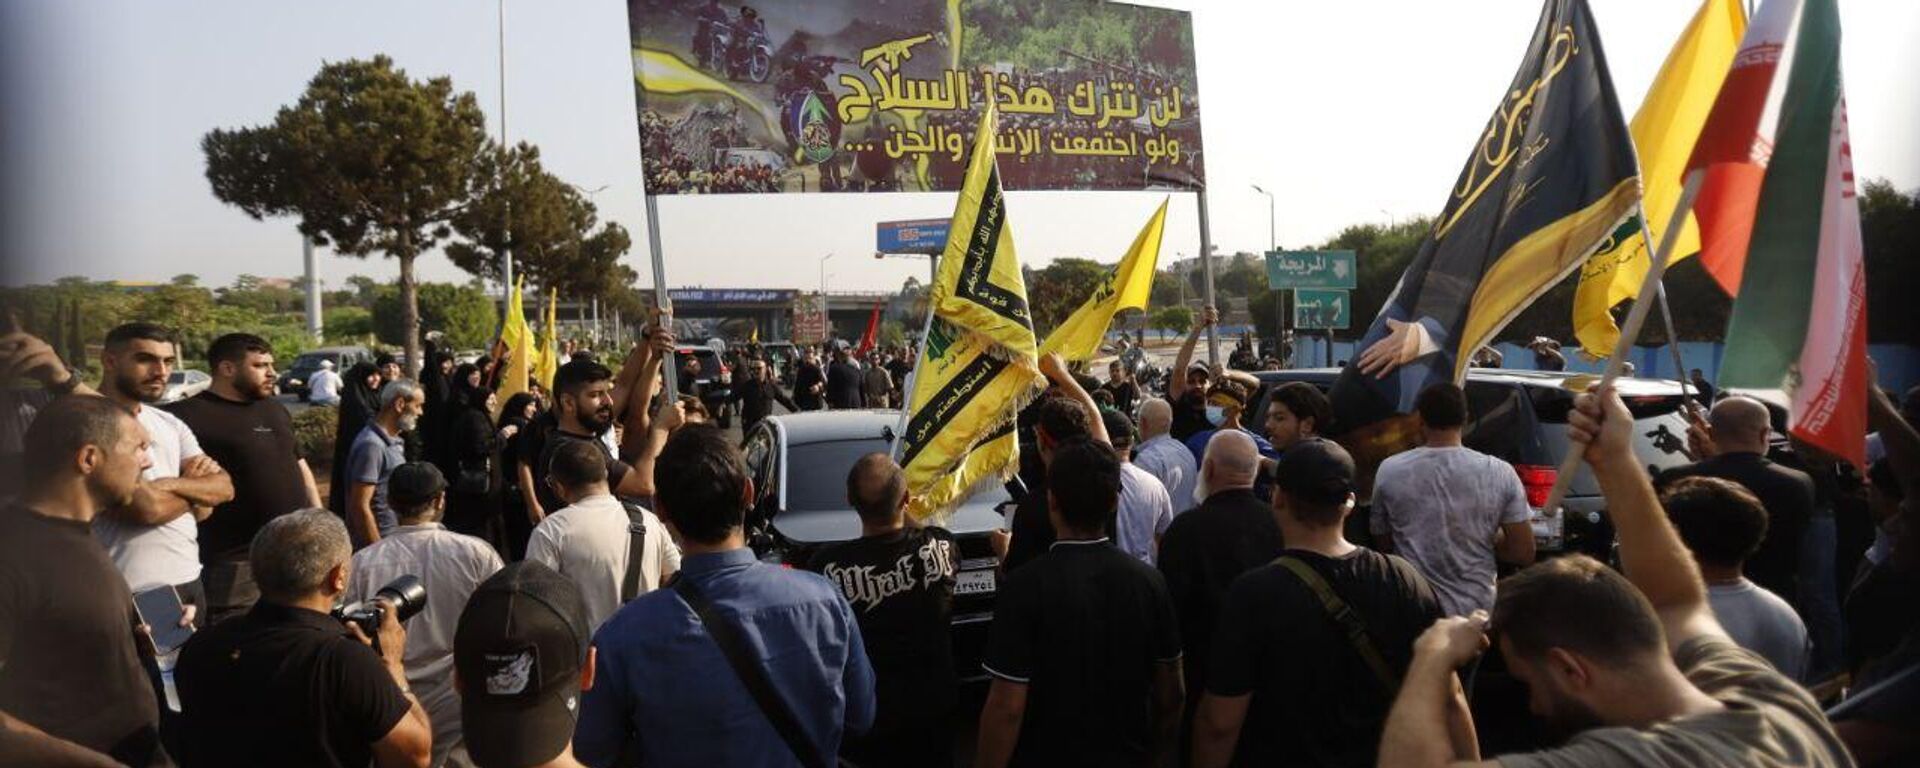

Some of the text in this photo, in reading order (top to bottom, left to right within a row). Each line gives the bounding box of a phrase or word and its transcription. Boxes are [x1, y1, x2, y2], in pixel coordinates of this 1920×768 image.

[837, 67, 1181, 128] لن نترك هذا السلاح
[884, 124, 964, 162] والجن
[1051, 131, 1138, 162] اجتمعت
[1145, 132, 1180, 164] ولو
[1276, 254, 1326, 275] المريجة
[824, 554, 916, 613] What
